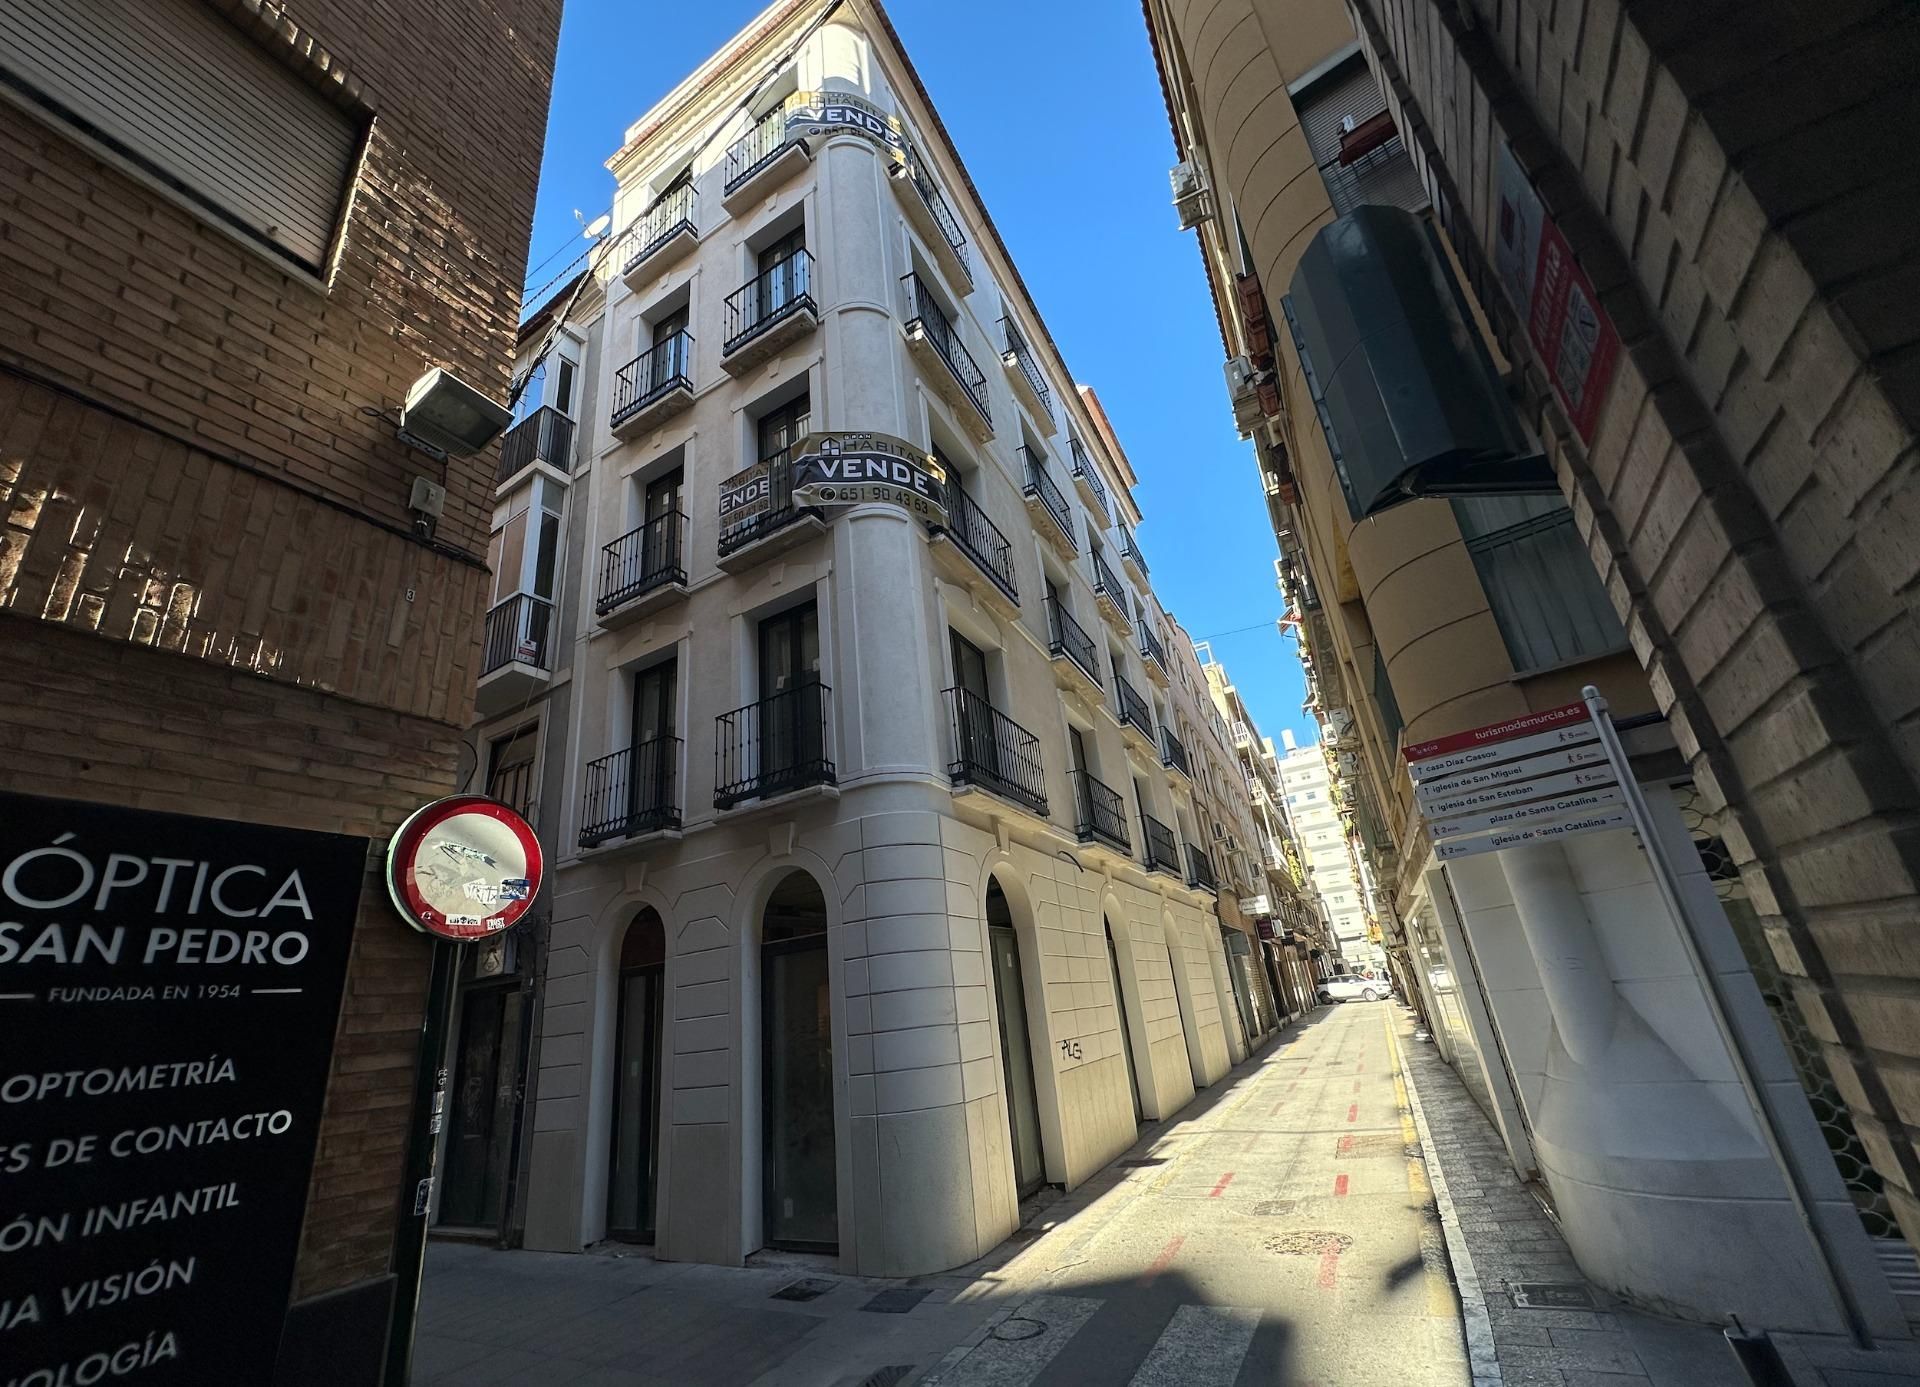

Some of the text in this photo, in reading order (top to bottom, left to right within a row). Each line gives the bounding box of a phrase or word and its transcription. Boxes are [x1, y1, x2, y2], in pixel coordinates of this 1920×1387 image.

[806, 108, 901, 147] VENDE
[843, 440, 928, 469] HABITAT
[817, 458, 929, 495] VENDE
[840, 487, 928, 515] 651 90 43 63
[1475, 706, 1581, 740] turismodemurcia.es
[1426, 762, 1444, 772] casa
[1465, 750, 1497, 762] Cassou
[1432, 781, 1459, 793] iglesia
[1473, 774, 1490, 783] San
[1491, 766, 1522, 780] Miguel
[1438, 799, 1465, 812] iglesia
[1466, 796, 1478, 805] de
[1479, 793, 1496, 802] San
[1498, 786, 1534, 798] Esteban
[1490, 814, 1514, 824] plaza
[1515, 809, 1527, 818] de
[1529, 804, 1556, 815] Santa
[1557, 796, 1598, 809] Catalina
[1491, 832, 1521, 846] iglesia
[1523, 830, 1534, 839] de
[1536, 826, 1564, 837] Santa
[1565, 817, 1607, 831] Catalina
[2, 831, 314, 920] ÓPTICA
[0, 921, 309, 965] SAN PEDRO
[48, 984, 241, 1002] FUNDADA EN 1954
[0, 1053, 237, 1103] OPTOMETRÍA
[44, 1135, 98, 1168] DE
[109, 1109, 293, 1157] CONTACTO
[81, 1181, 240, 1237] INFANTIL
[61, 1256, 196, 1316] VISIÓN
[7, 1330, 178, 1387] OLOGÍA
